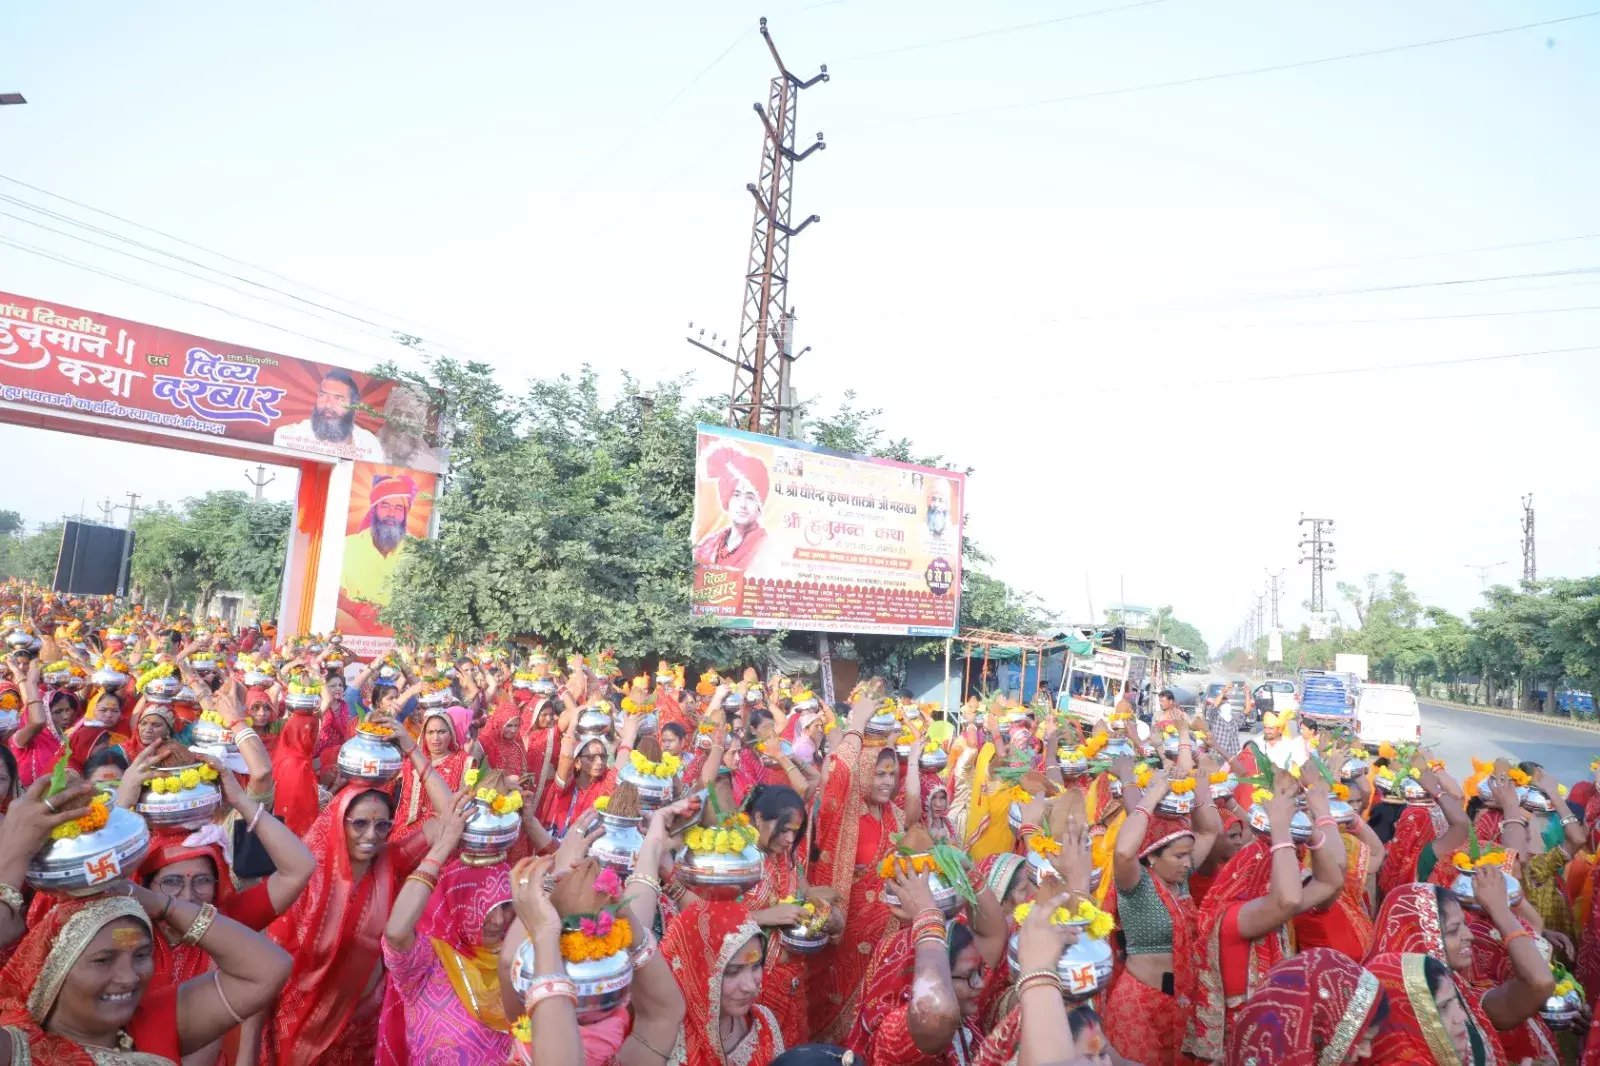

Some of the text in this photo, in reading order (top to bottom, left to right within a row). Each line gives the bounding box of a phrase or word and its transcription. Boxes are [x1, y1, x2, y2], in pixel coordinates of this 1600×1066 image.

[32, 307, 108, 336] दिवसीय
[146, 353, 169, 367] एवं
[184, 347, 260, 384] दिव्य
[56, 355, 147, 398] कथा
[74, 397, 91, 411] का
[127, 406, 161, 424] स्वागत
[153, 374, 287, 426] दरबार
[786, 481, 798, 498] श्री
[874, 527, 905, 543] कथा
